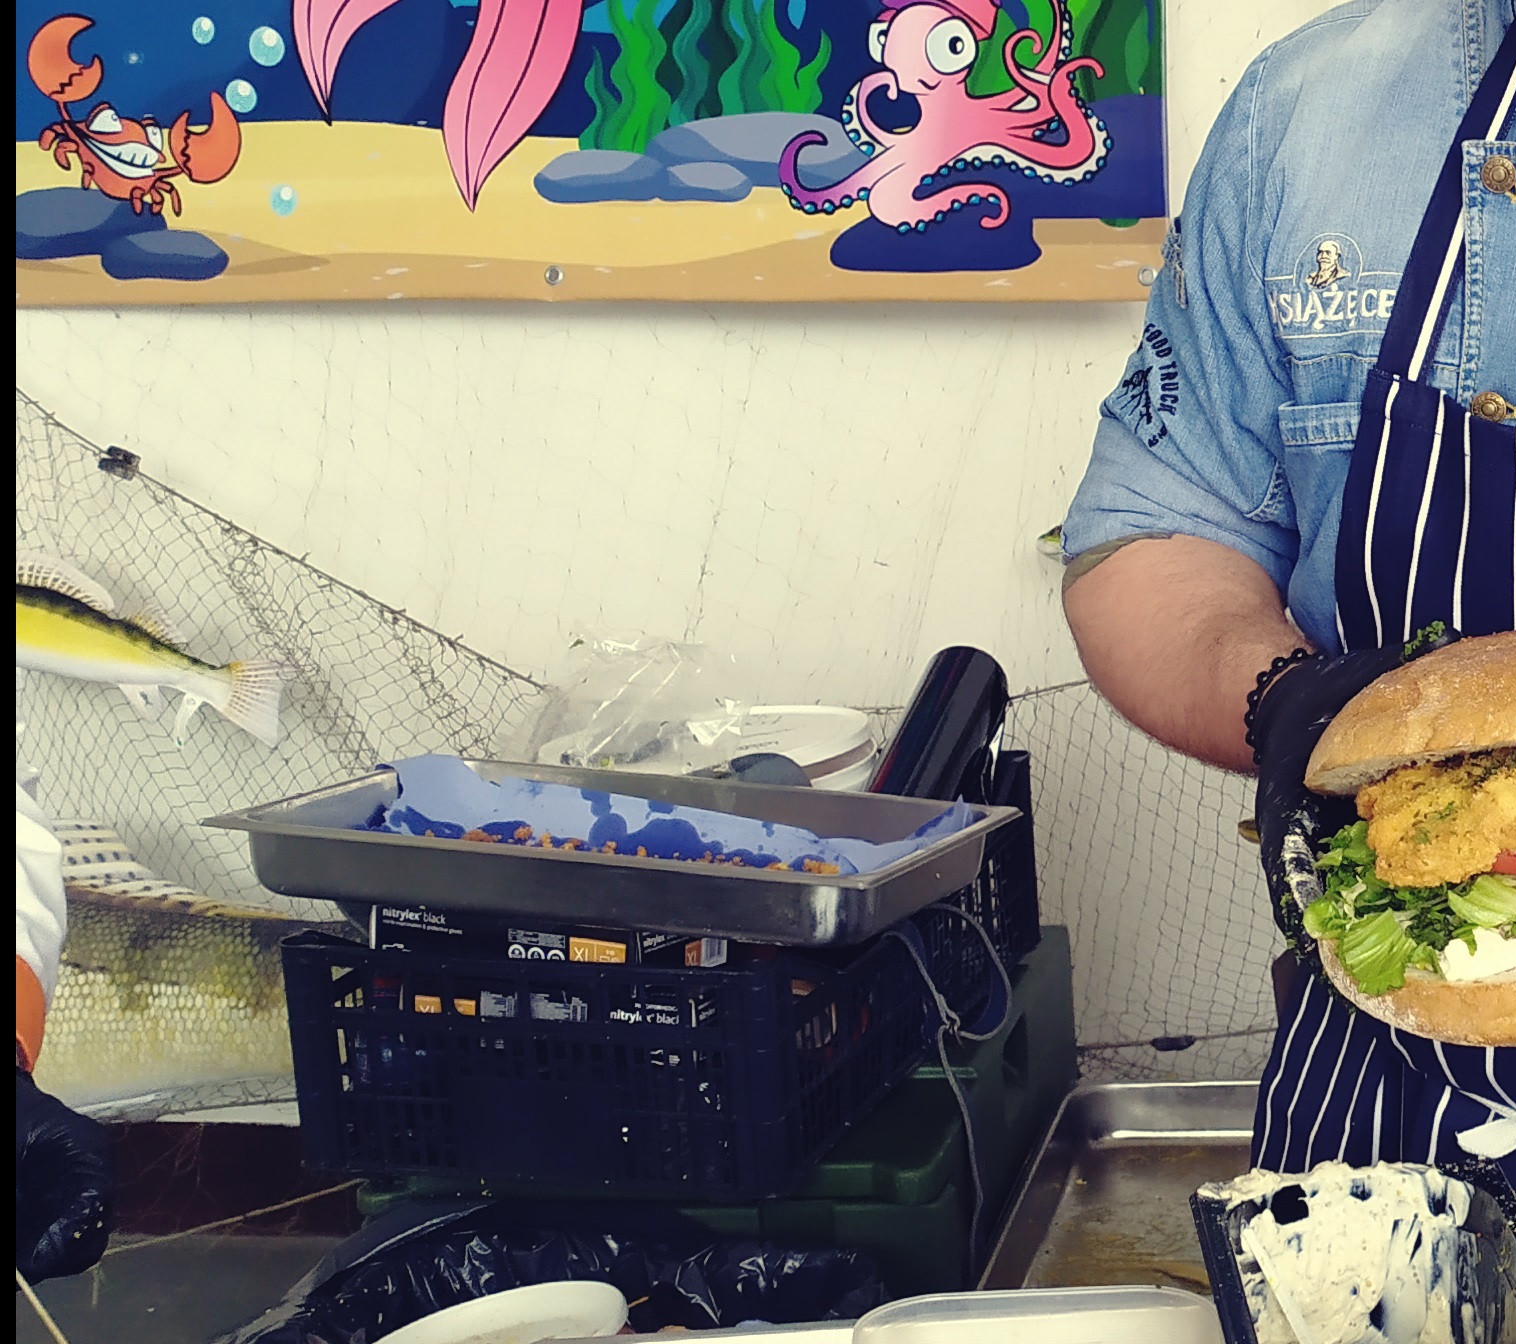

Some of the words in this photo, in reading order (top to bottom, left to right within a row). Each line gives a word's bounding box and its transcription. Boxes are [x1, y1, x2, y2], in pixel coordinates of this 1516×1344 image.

[1144, 323, 1172, 358] FOOD
[1158, 361, 1179, 416] TRUCK
[423, 911, 446, 925] black
